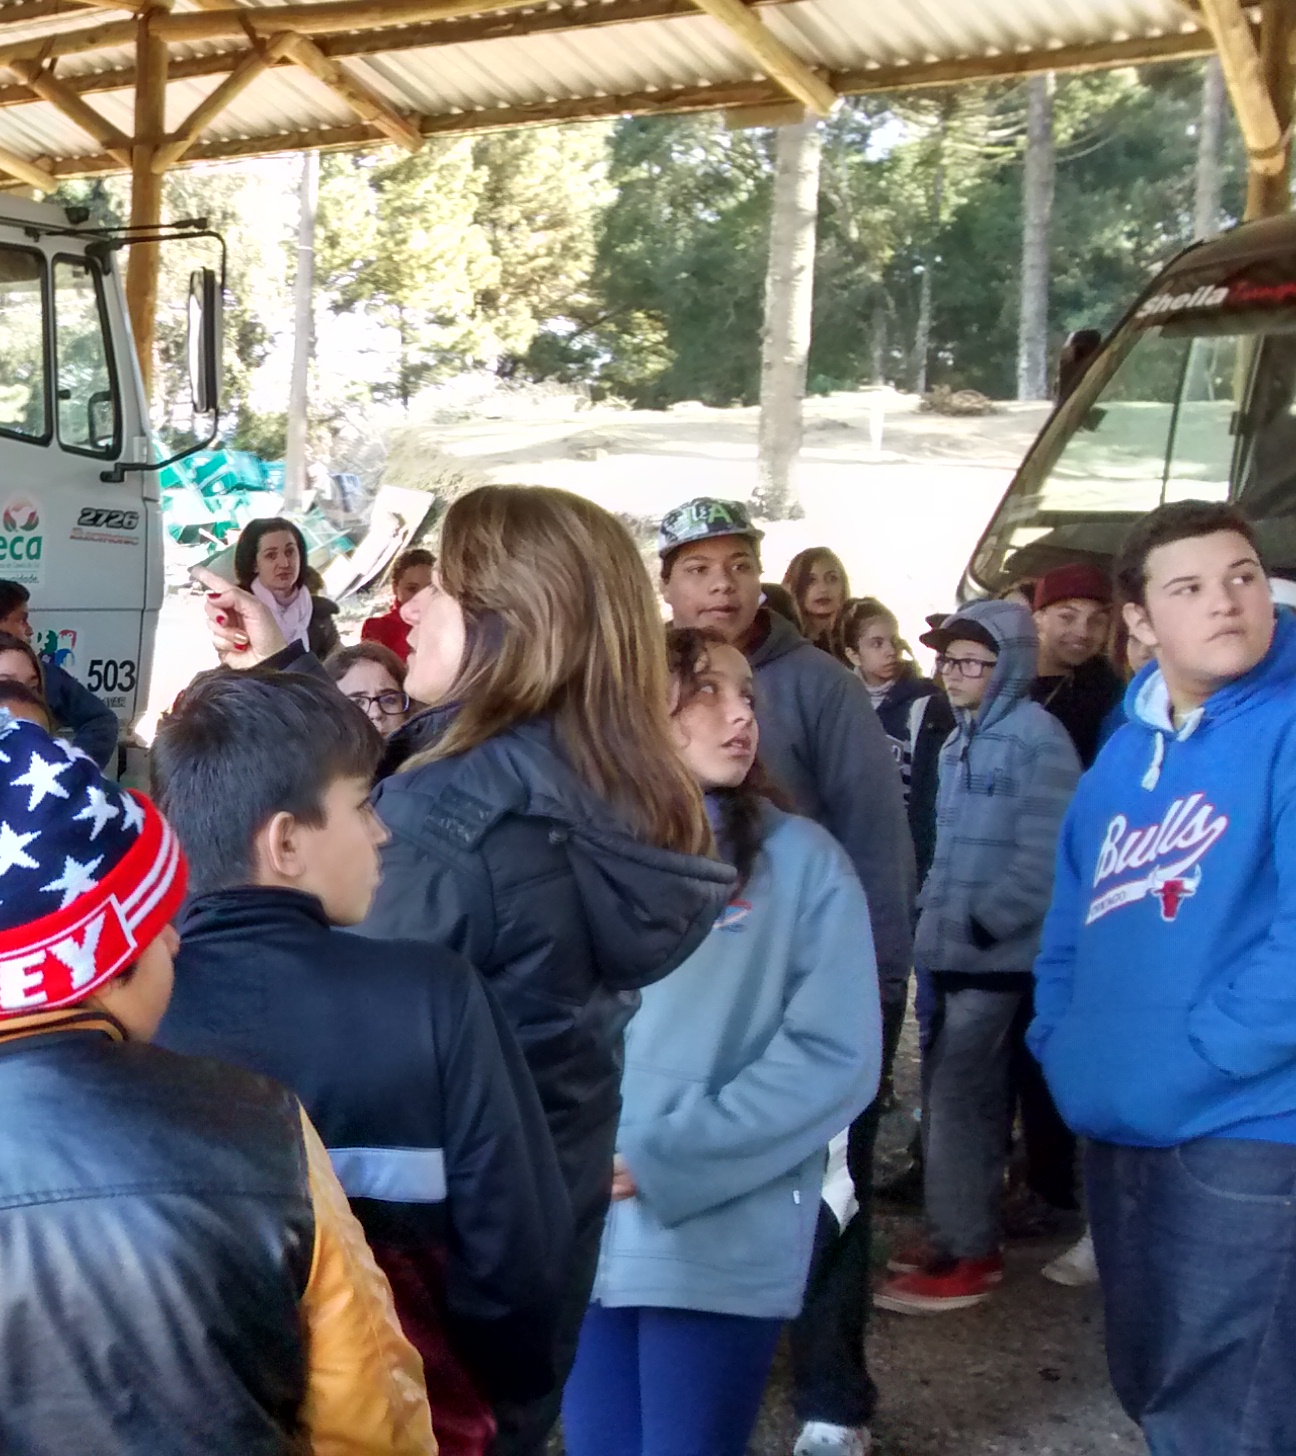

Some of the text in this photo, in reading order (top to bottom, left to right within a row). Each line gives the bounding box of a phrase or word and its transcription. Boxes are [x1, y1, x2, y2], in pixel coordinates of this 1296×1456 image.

[78, 507, 140, 530] 2726
[87, 659, 136, 693] 503
[1093, 792, 1228, 888] Bulls
